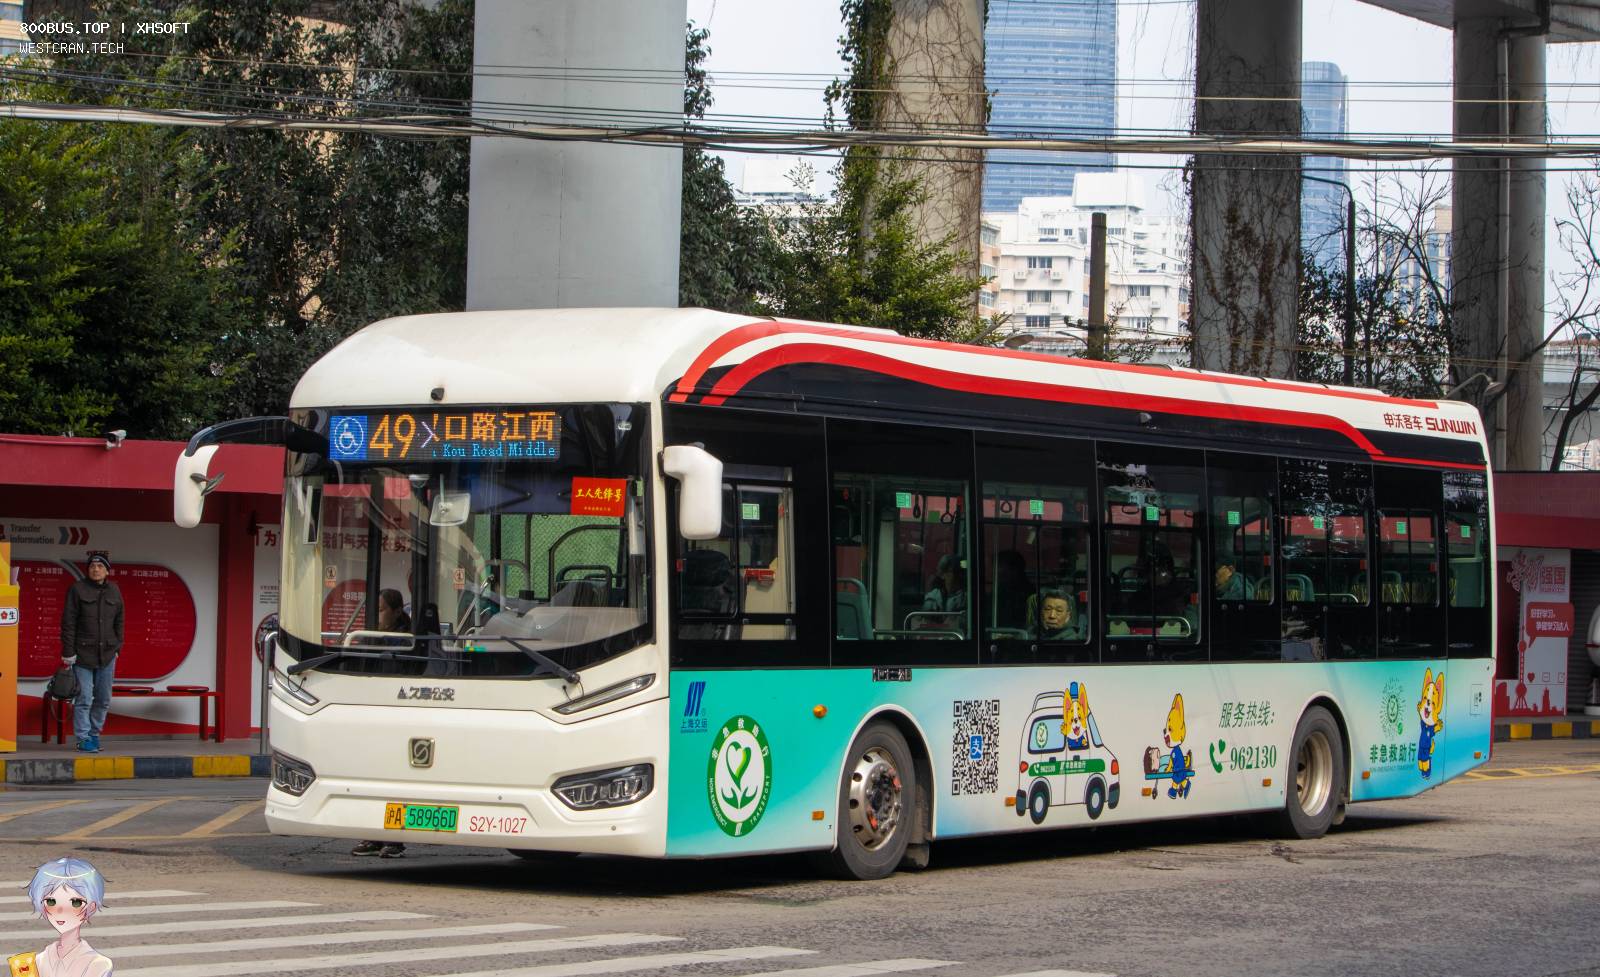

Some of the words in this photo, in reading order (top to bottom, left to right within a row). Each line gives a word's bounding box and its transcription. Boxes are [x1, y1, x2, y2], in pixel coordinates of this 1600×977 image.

[1383, 413, 1423, 431] 申沃客车
[1425, 416, 1477, 435] SUNWIN
[369, 413, 416, 457] 49
[443, 443, 466, 457] Kou
[472, 442, 503, 456] Road
[508, 441, 555, 456] Middle
[575, 487, 622, 503] 工人先锋号
[10, 524, 41, 533] Transfer
[1230, 745, 1277, 771] 962130
[469, 815, 527, 834] S2Y-1027
